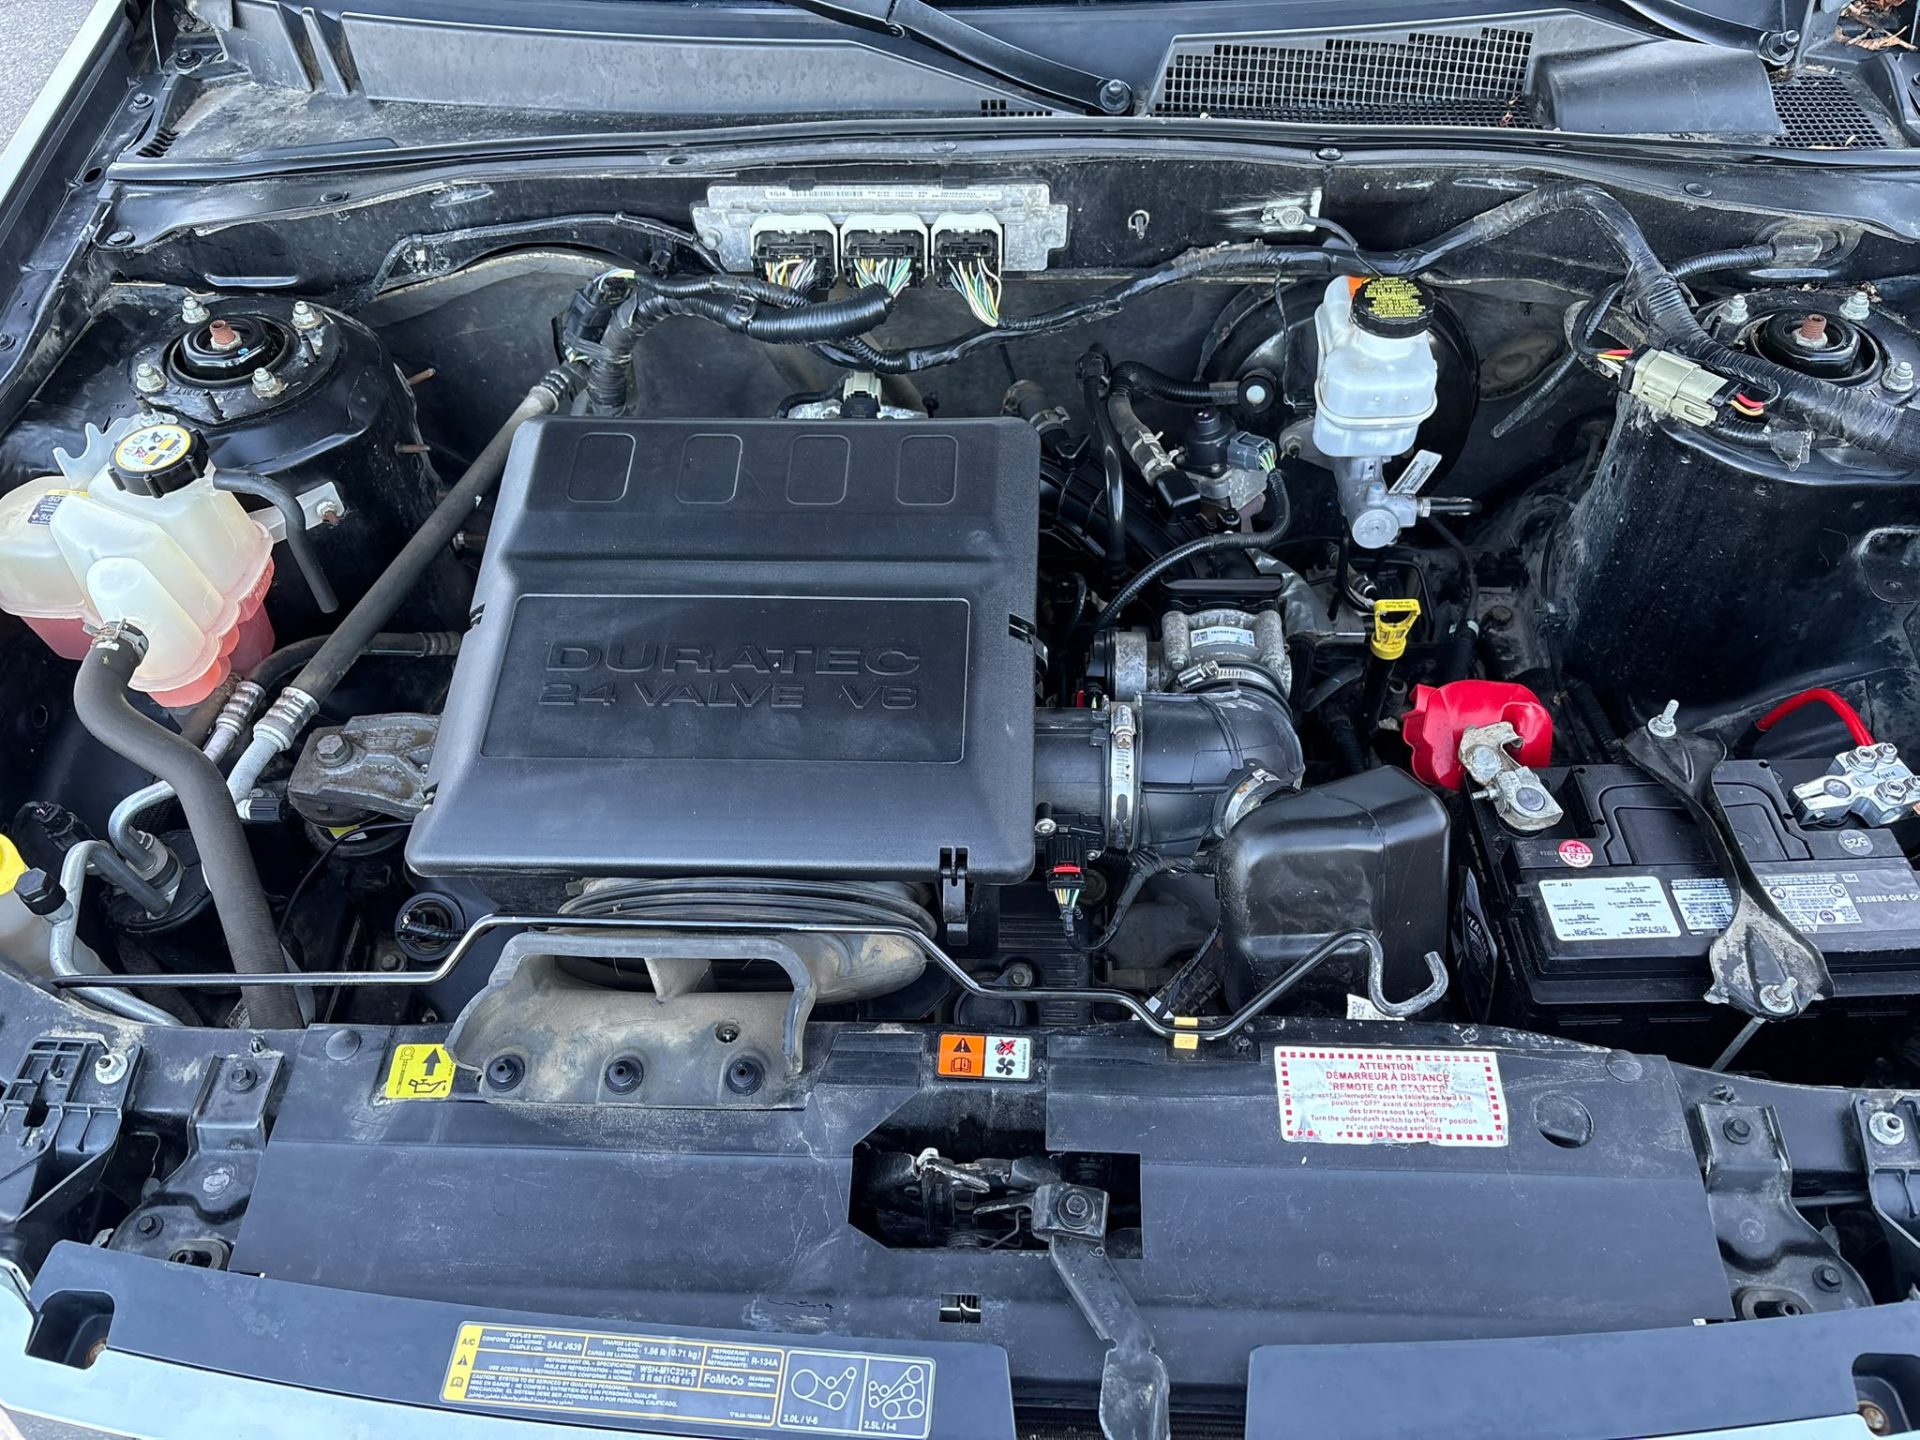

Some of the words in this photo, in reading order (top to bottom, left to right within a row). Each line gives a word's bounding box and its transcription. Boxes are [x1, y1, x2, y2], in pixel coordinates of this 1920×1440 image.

[546, 643, 920, 675] DURATEC
[538, 682, 617, 706] 24
[632, 682, 805, 708] VALVE
[841, 684, 918, 709] V6
[1844, 836, 1869, 849] 5/25
[1855, 893, 1909, 903] PRO-SERIES
[1358, 1062, 1414, 1071] ATTENTION
[1325, 1070, 1388, 1081] DÉMARREUR
[1391, 1070, 1399, 1081] À
[1400, 1072, 1450, 1083] DISTANCE
[1332, 1082, 1374, 1092] REMOTE
[1376, 1082, 1398, 1092] CAR
[1401, 1083, 1446, 1094] STARTER
[1331, 1099, 1359, 1107] position
[1360, 1099, 1381, 1107] "OFF"
[1341, 1115, 1380, 1123] under-dash
[1414, 1116, 1425, 1124] the
[1426, 1116, 1448, 1125] "OFF"
[1448, 1117, 1478, 1127] position
[1370, 1123, 1408, 1132] underhood
[461, 1338, 476, 1347] A/C
[481, 1335, 512, 1344] CONFORME
[602, 1339, 624, 1347] CHARGE
[547, 1341, 564, 1350] SAE
[564, 1341, 582, 1351] J639
[616, 1346, 638, 1354] CHARGE
[587, 1349, 606, 1357] CARGA
[659, 1347, 667, 1357] lb
[667, 1348, 687, 1358] (0.71
[687, 1350, 702, 1361] kg)
[545, 1357, 582, 1366] REFRIGERANT
[750, 1356, 779, 1367] R-134A
[500, 1365, 519, 1373] ACEITE
[519, 1366, 534, 1374] PARA
[534, 1367, 578, 1377] REFRIGERANTES
[577, 1370, 608, 1380] CONFORME
[472, 1373, 497, 1381] CAUTION:
[498, 1375, 520, 1383] SYSTEM
[535, 1378, 562, 1387] SERVICED
[570, 1380, 597, 1389] QUALIFIED
[680, 1376, 695, 1387] cc)
[703, 1373, 745, 1386] FoMoCo
[491, 1380, 510, 1388] GARDE
[523, 1383, 545, 1391] CONFIER
[600, 1388, 634, 1399] PERSONNEL
[513, 1388, 536, 1397] SISTEMA
[536, 1390, 551, 1398] DEBE
[563, 1392, 590, 1401] ATENDIDO
[589, 1394, 605, 1402] SOLO
[616, 1396, 645, 1406] PERSONAL
[783, 1414, 800, 1424] 3.0L
[805, 1415, 819, 1425] V-6
[863, 1420, 881, 1430] 2.5L
[886, 1422, 897, 1431] I-4
